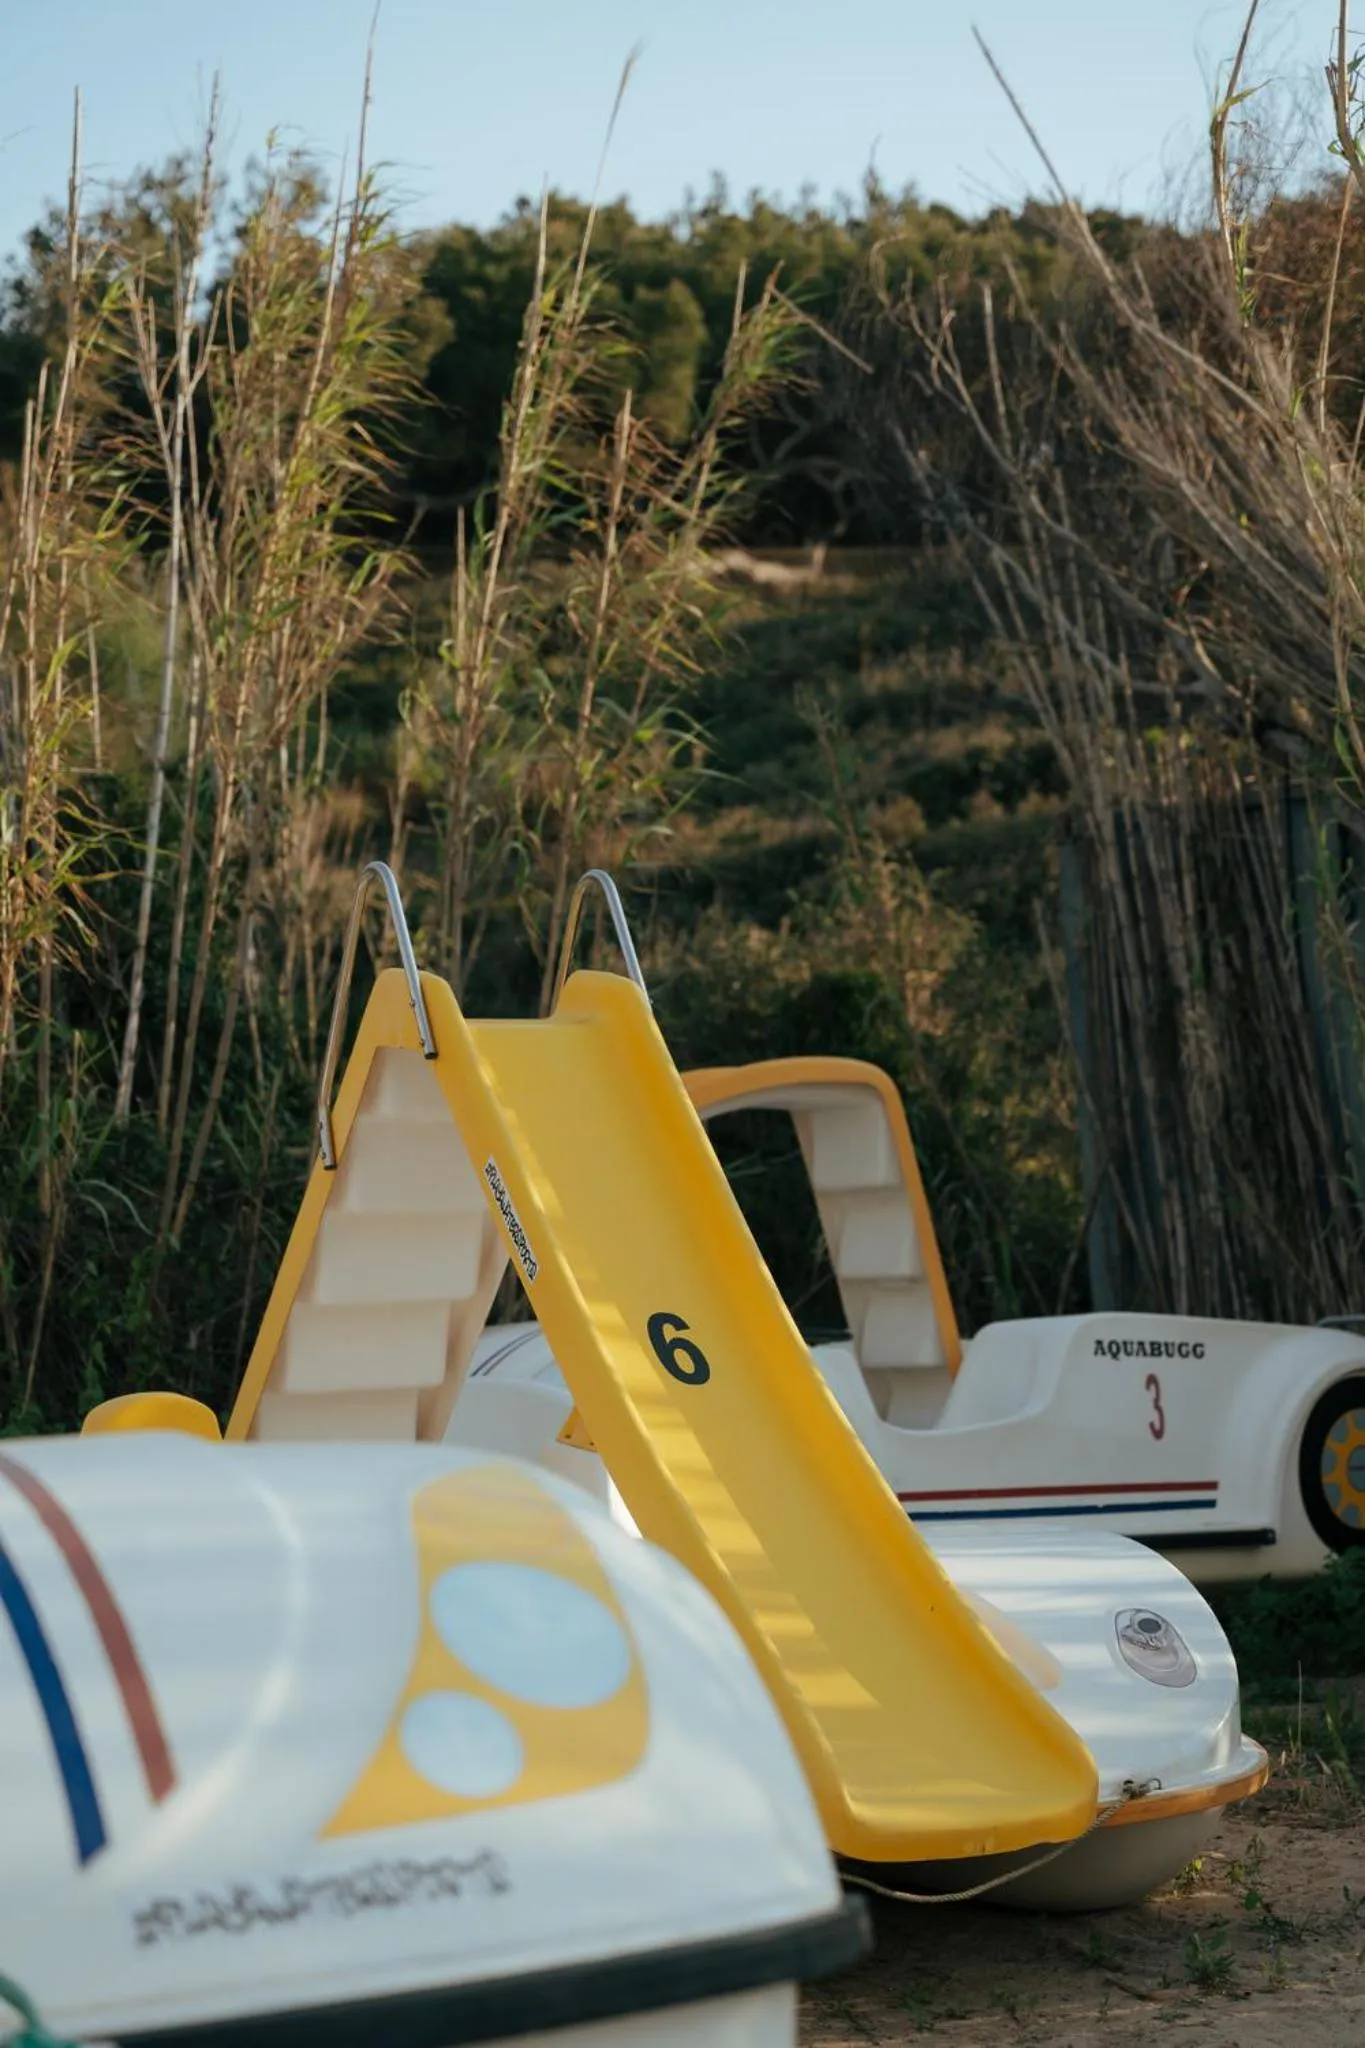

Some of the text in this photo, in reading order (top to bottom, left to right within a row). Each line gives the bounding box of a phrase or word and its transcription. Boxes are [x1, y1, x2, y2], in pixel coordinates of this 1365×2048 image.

[646, 1311, 711, 1386] 6
[1093, 1339, 1206, 1361] AQUABUGG
[1145, 1373, 1165, 1441] 3
